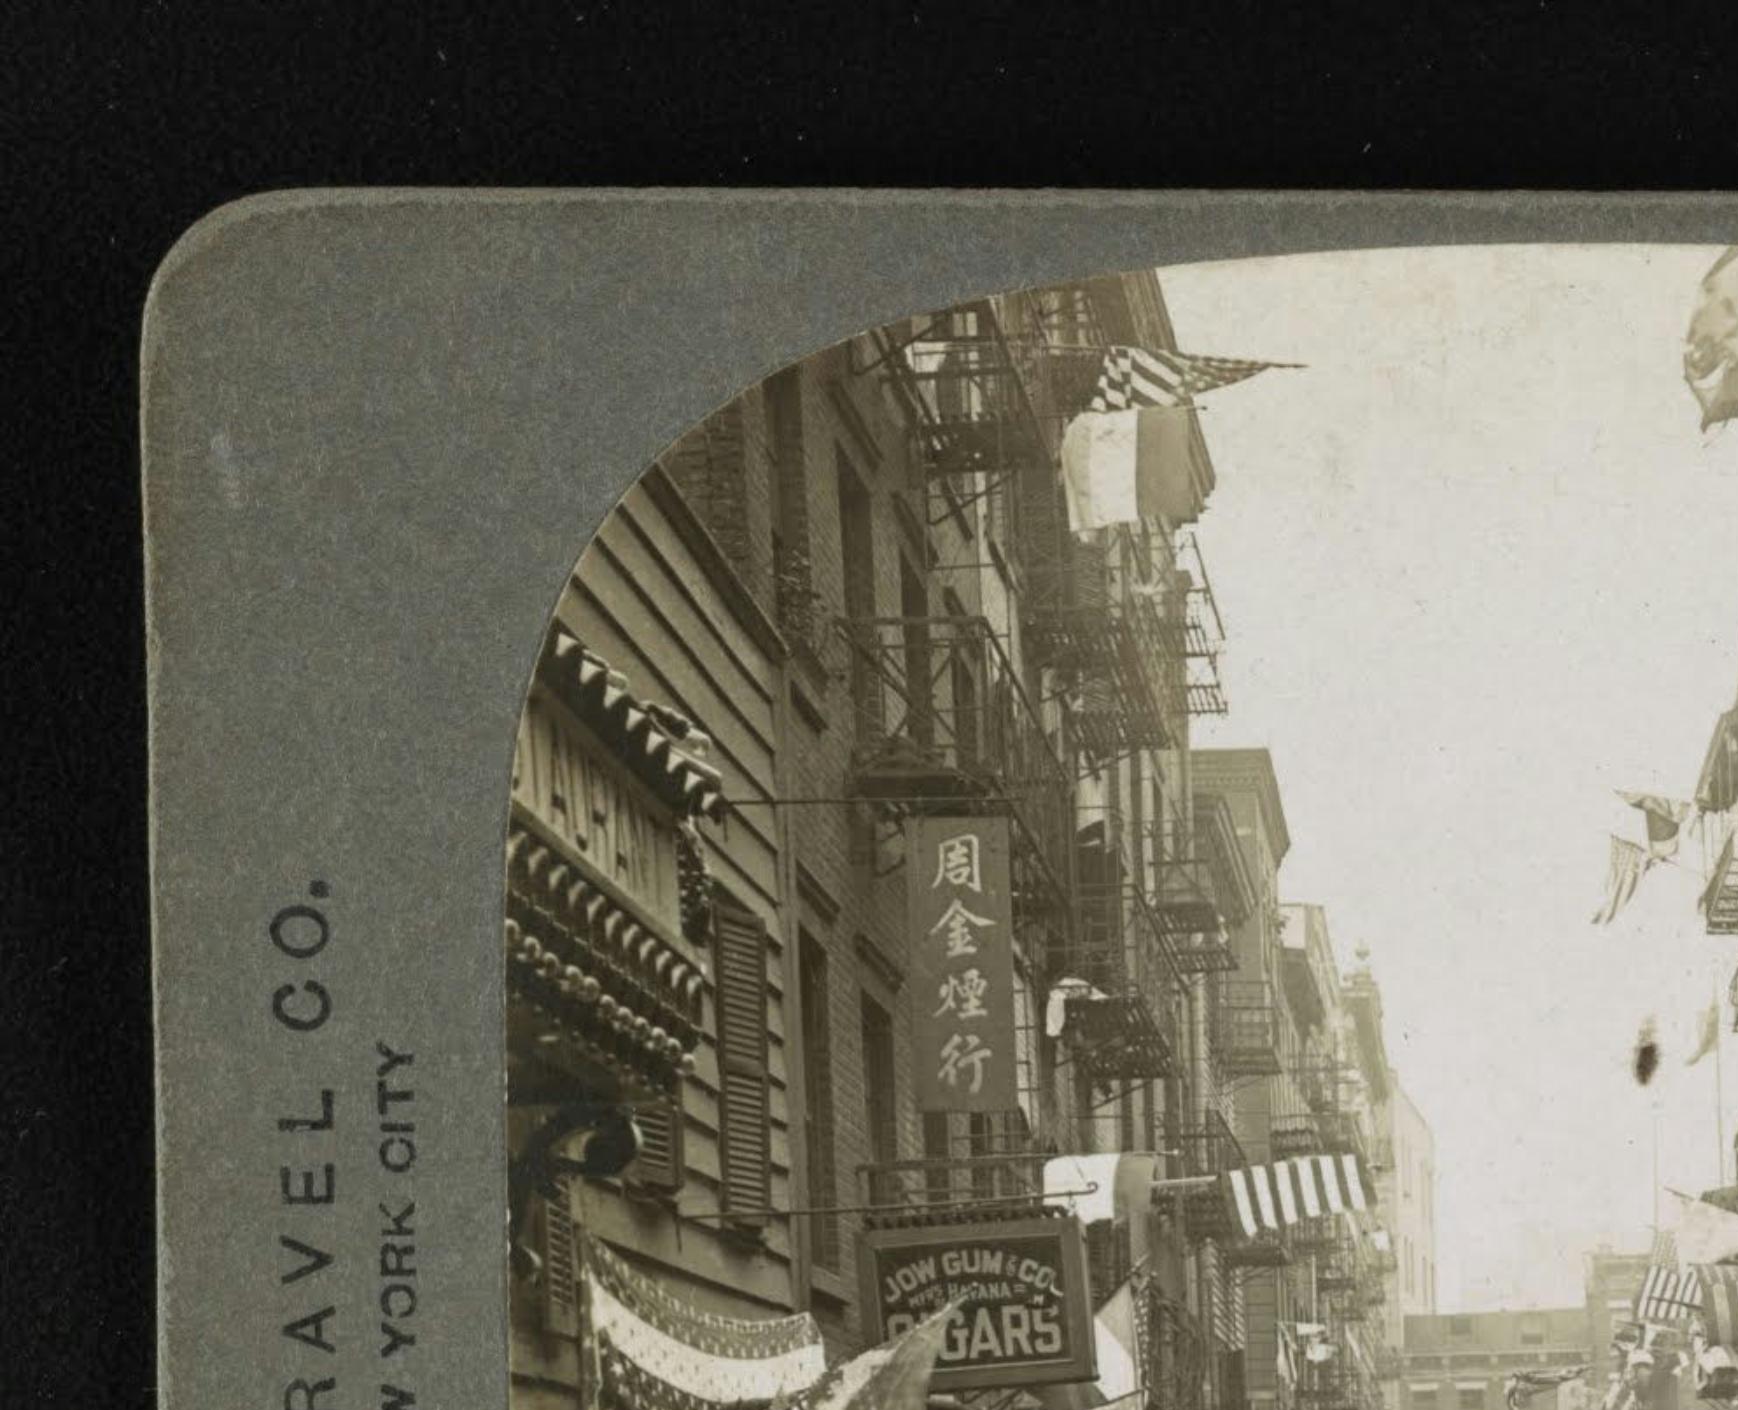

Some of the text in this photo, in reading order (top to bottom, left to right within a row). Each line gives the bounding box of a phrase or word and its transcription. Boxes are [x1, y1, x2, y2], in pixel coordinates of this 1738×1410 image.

[269, 880, 331, 1031] CO.
[377, 1043, 416, 1173] CITY
[379, 1203, 416, 1357] YORK
[885, 1257, 936, 1303] JOW
[941, 1250, 1003, 1276] GUM
[886, 1303, 1062, 1361] CGARS
